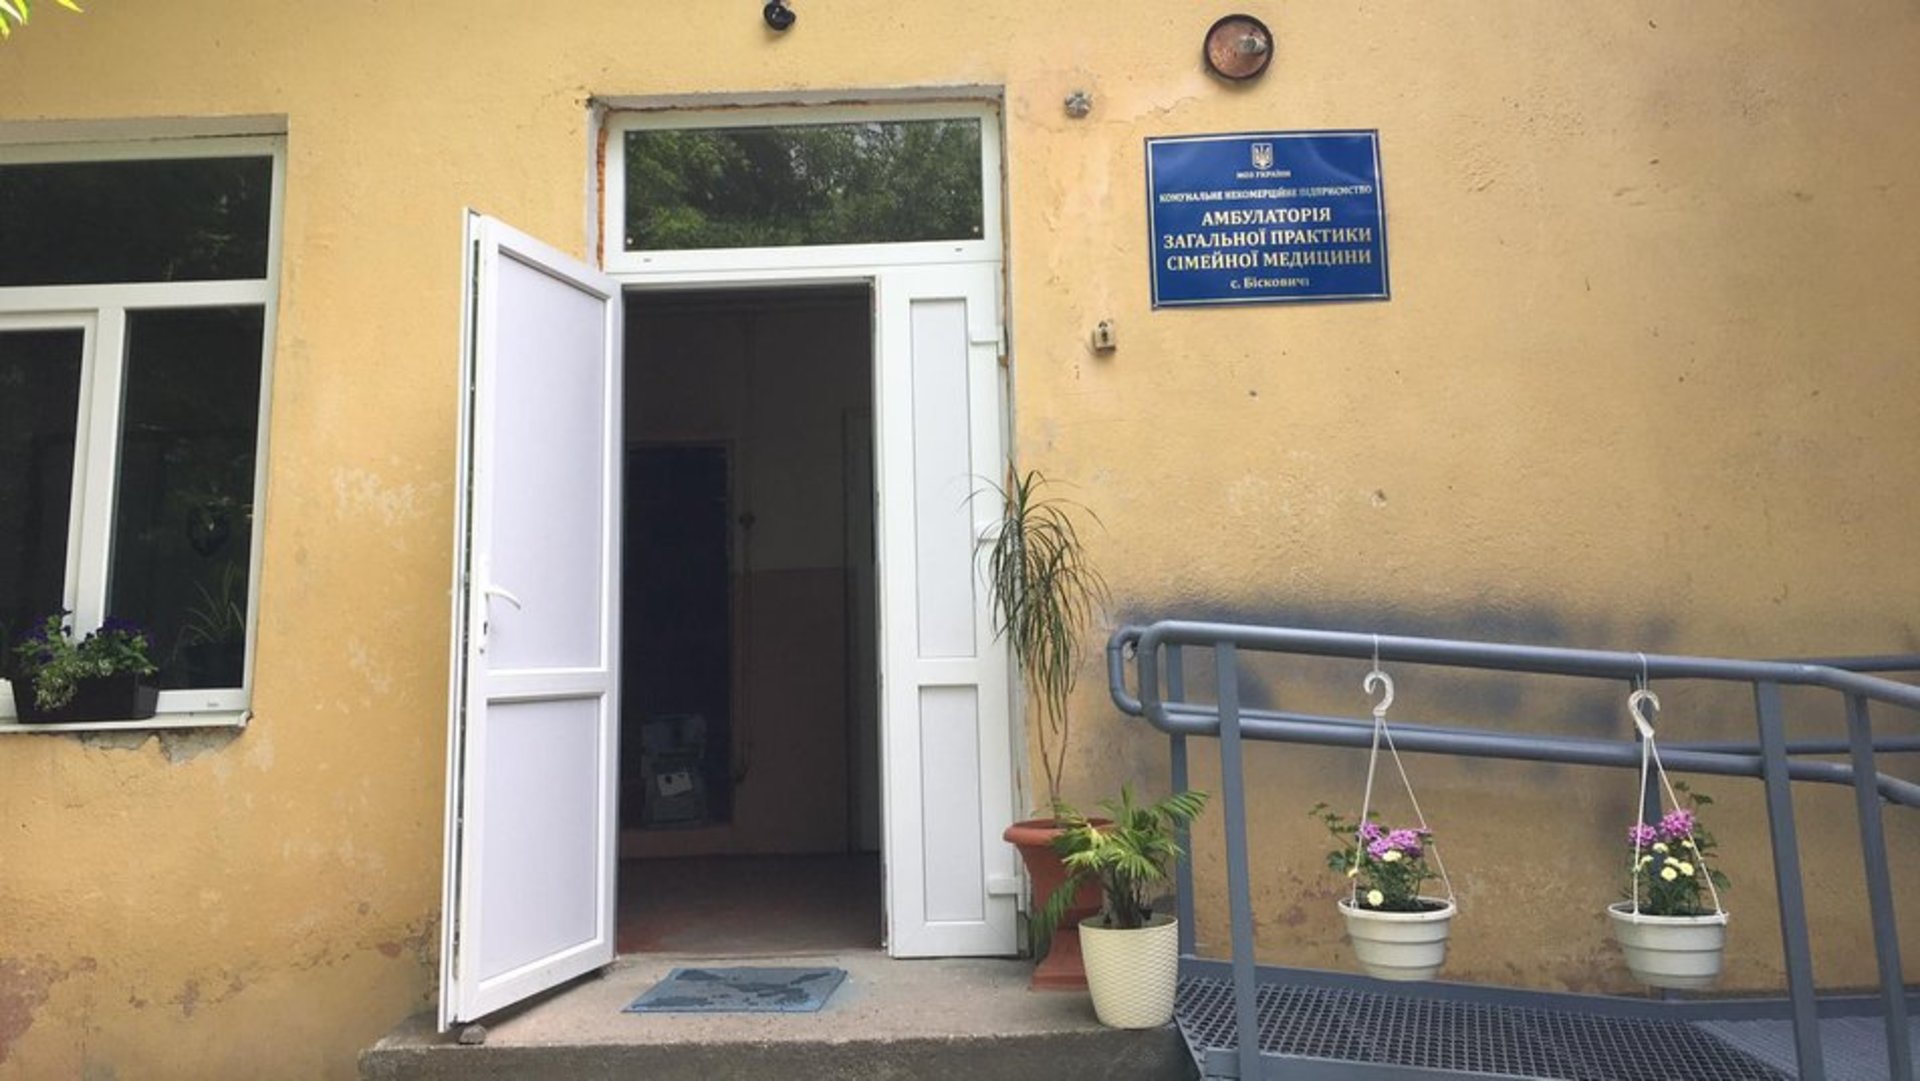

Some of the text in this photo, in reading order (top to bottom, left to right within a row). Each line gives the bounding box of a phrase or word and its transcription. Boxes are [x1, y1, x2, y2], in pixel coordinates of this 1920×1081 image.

[1255, 170, 1291, 179] УКРАЇНИ
[1159, 185, 1373, 202] КОМУНАЛЬНЕ НЕКОМЕРЦІЙНЕ ПІДПРИЄМСТВО
[1201, 207, 1331, 227] АМБУЛАТОРІЯ
[1163, 227, 1372, 249] ЗАГАЛЬНОЇ ПРАКТИКИ
[1166, 249, 1372, 271] СІМЕЙНОЇ МЕДИЦИНИ
[1230, 277, 1310, 290] с. Бісковичі
